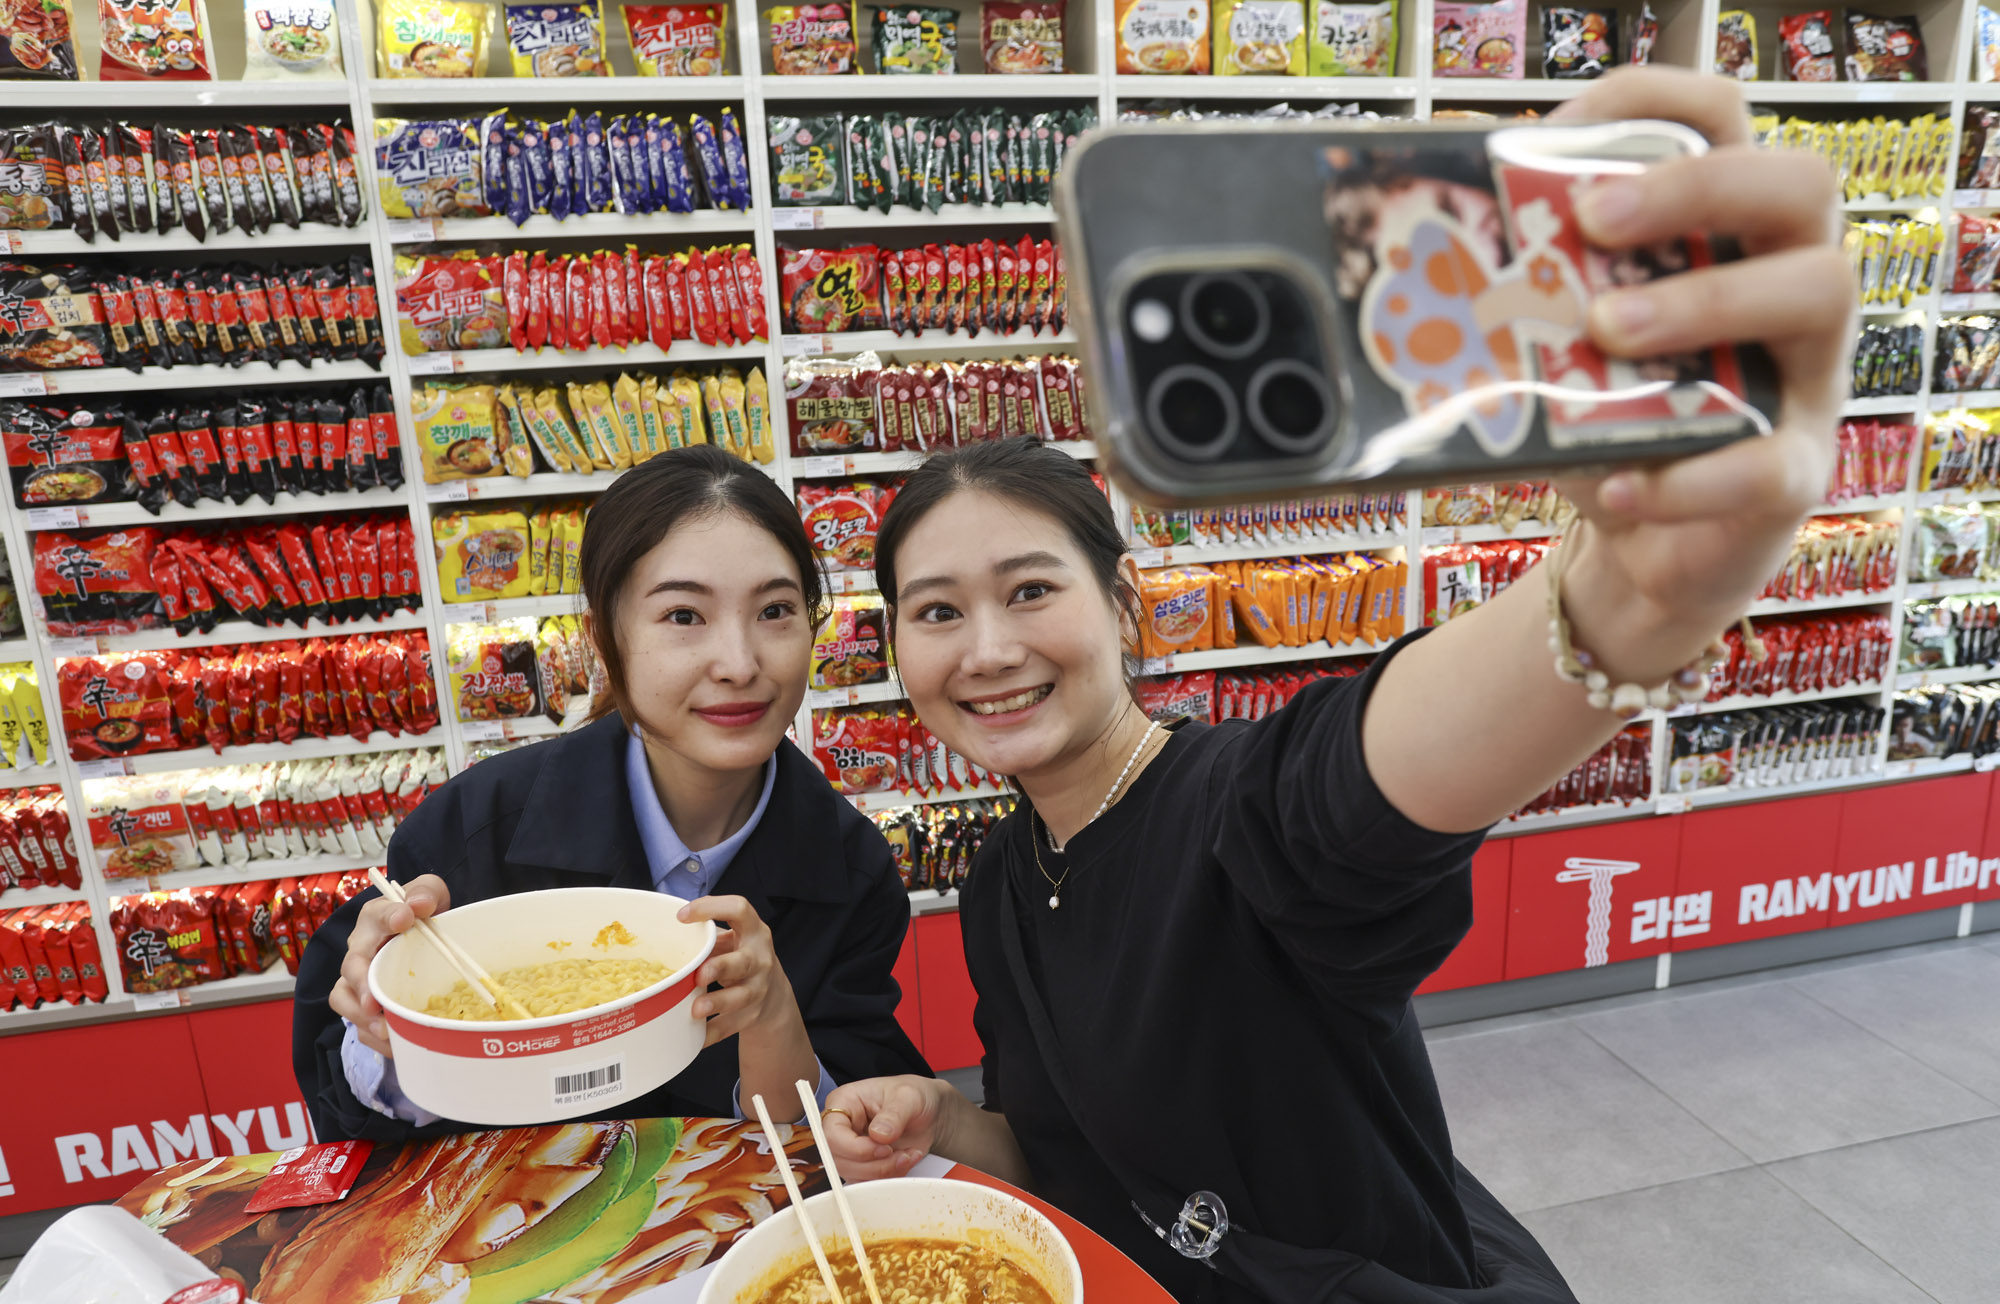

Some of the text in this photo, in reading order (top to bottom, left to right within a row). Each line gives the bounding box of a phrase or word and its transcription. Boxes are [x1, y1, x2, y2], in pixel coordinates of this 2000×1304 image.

[512, 19, 592, 54] 진라면
[639, 22, 715, 57] 진라면
[50, 297, 74, 309] 두부
[817, 267, 864, 314] 열
[57, 311, 81, 323] 김치
[409, 290, 485, 328] 진라면
[798, 398, 871, 418] 해물짬뽕
[29, 426, 70, 469] 辛
[430, 422, 492, 445] 참깨라면
[813, 515, 868, 551] 왕뚜껑
[56, 545, 105, 600] 辛
[466, 551, 515, 575] 스낵면
[1154, 587, 1206, 618] 삼양라면
[813, 641, 846, 662] 크림
[82, 676, 118, 719] 辛
[461, 672, 527, 695] 진짬뽕
[828, 747, 886, 769] 김치라면
[109, 807, 139, 847] 辛
[141, 810, 173, 828] 건면
[1630, 890, 1713, 943] 라면
[1738, 861, 1914, 925] RAMYUN
[127, 928, 165, 976] 辛
[166, 928, 201, 950] 볶음면
[54, 1101, 320, 1185] RAMYU
